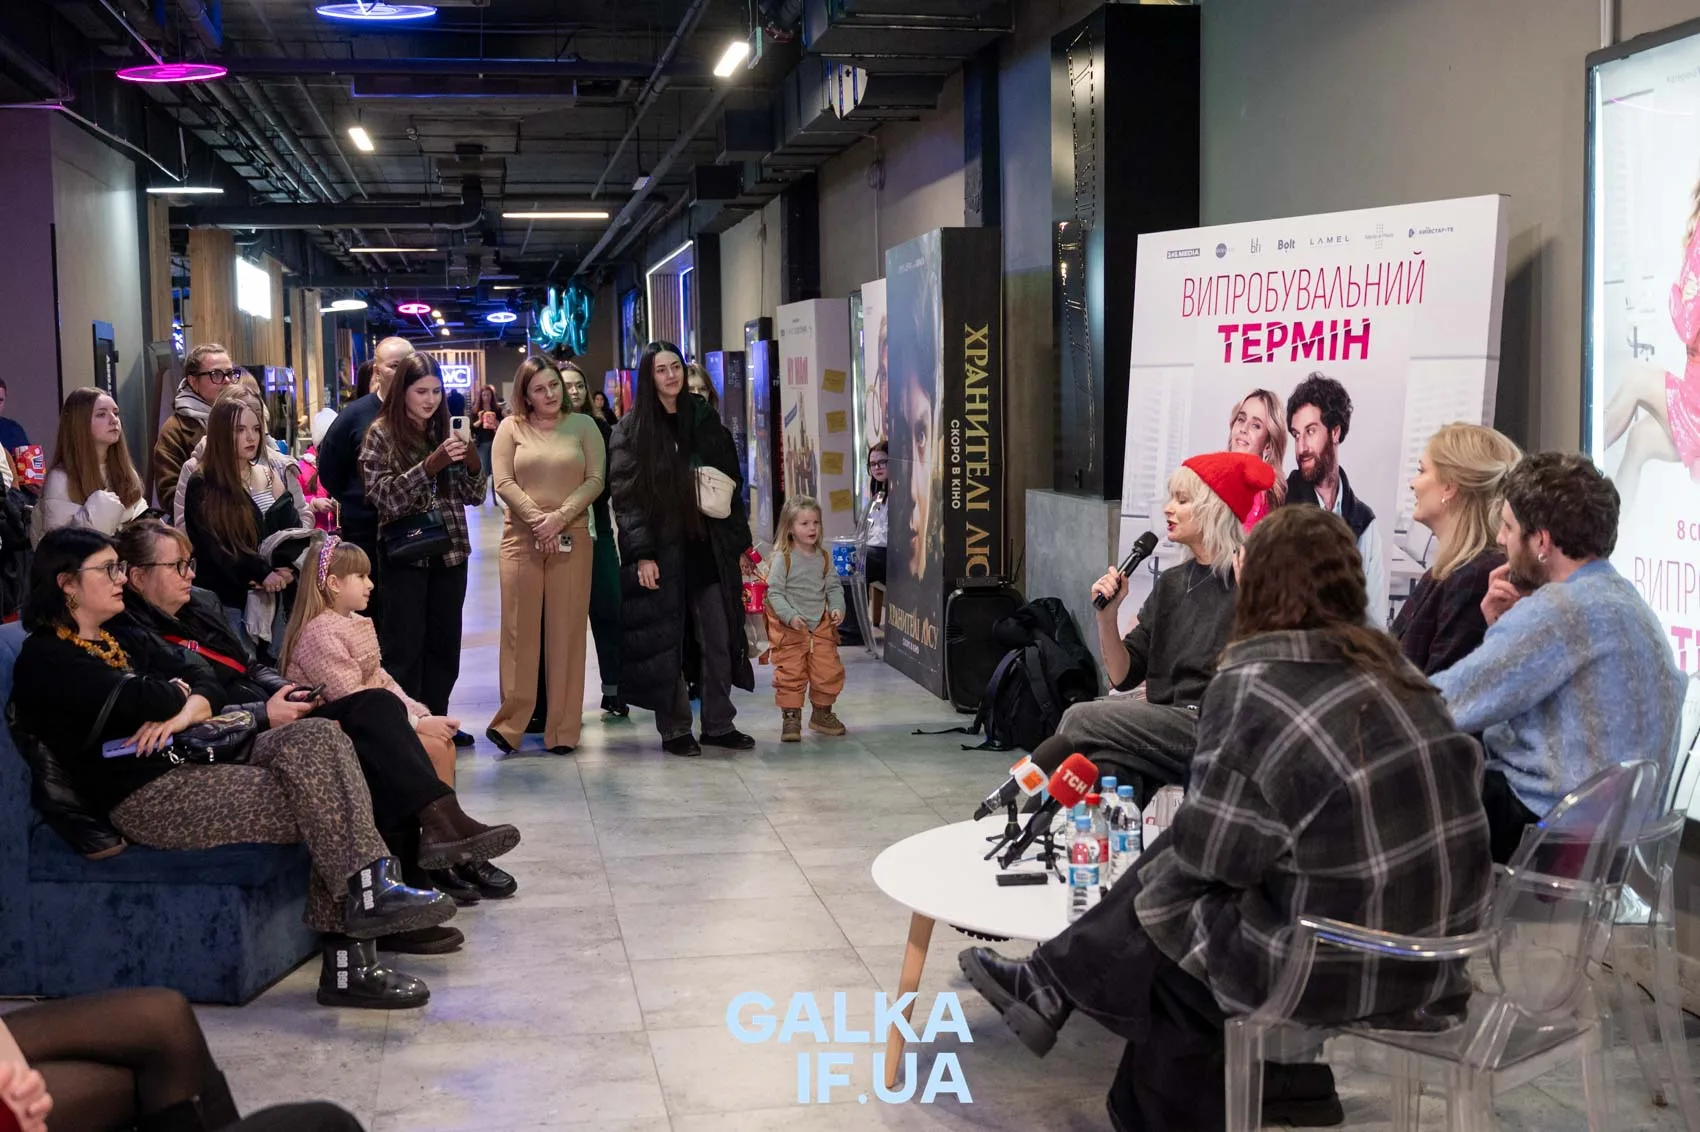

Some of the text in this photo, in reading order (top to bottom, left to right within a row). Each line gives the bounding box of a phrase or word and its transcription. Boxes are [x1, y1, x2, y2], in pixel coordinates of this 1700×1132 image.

[1277, 238, 1296, 252] Bolt
[1309, 235, 1350, 246] LAMEL
[1181, 251, 1426, 318] ВИПРОБУВАЛЬНИЙ
[1217, 318, 1372, 364] ТЕРМІН
[441, 368, 467, 384] WC
[964, 322, 991, 512] ХРАНИТЕЛІ
[950, 419, 961, 509] СКОРО В КІНО
[965, 520, 991, 577] ЛІС
[1676, 519, 1686, 541] 8
[1634, 556, 1700, 615] ВИПР
[1061, 769, 1089, 795] ТСН
